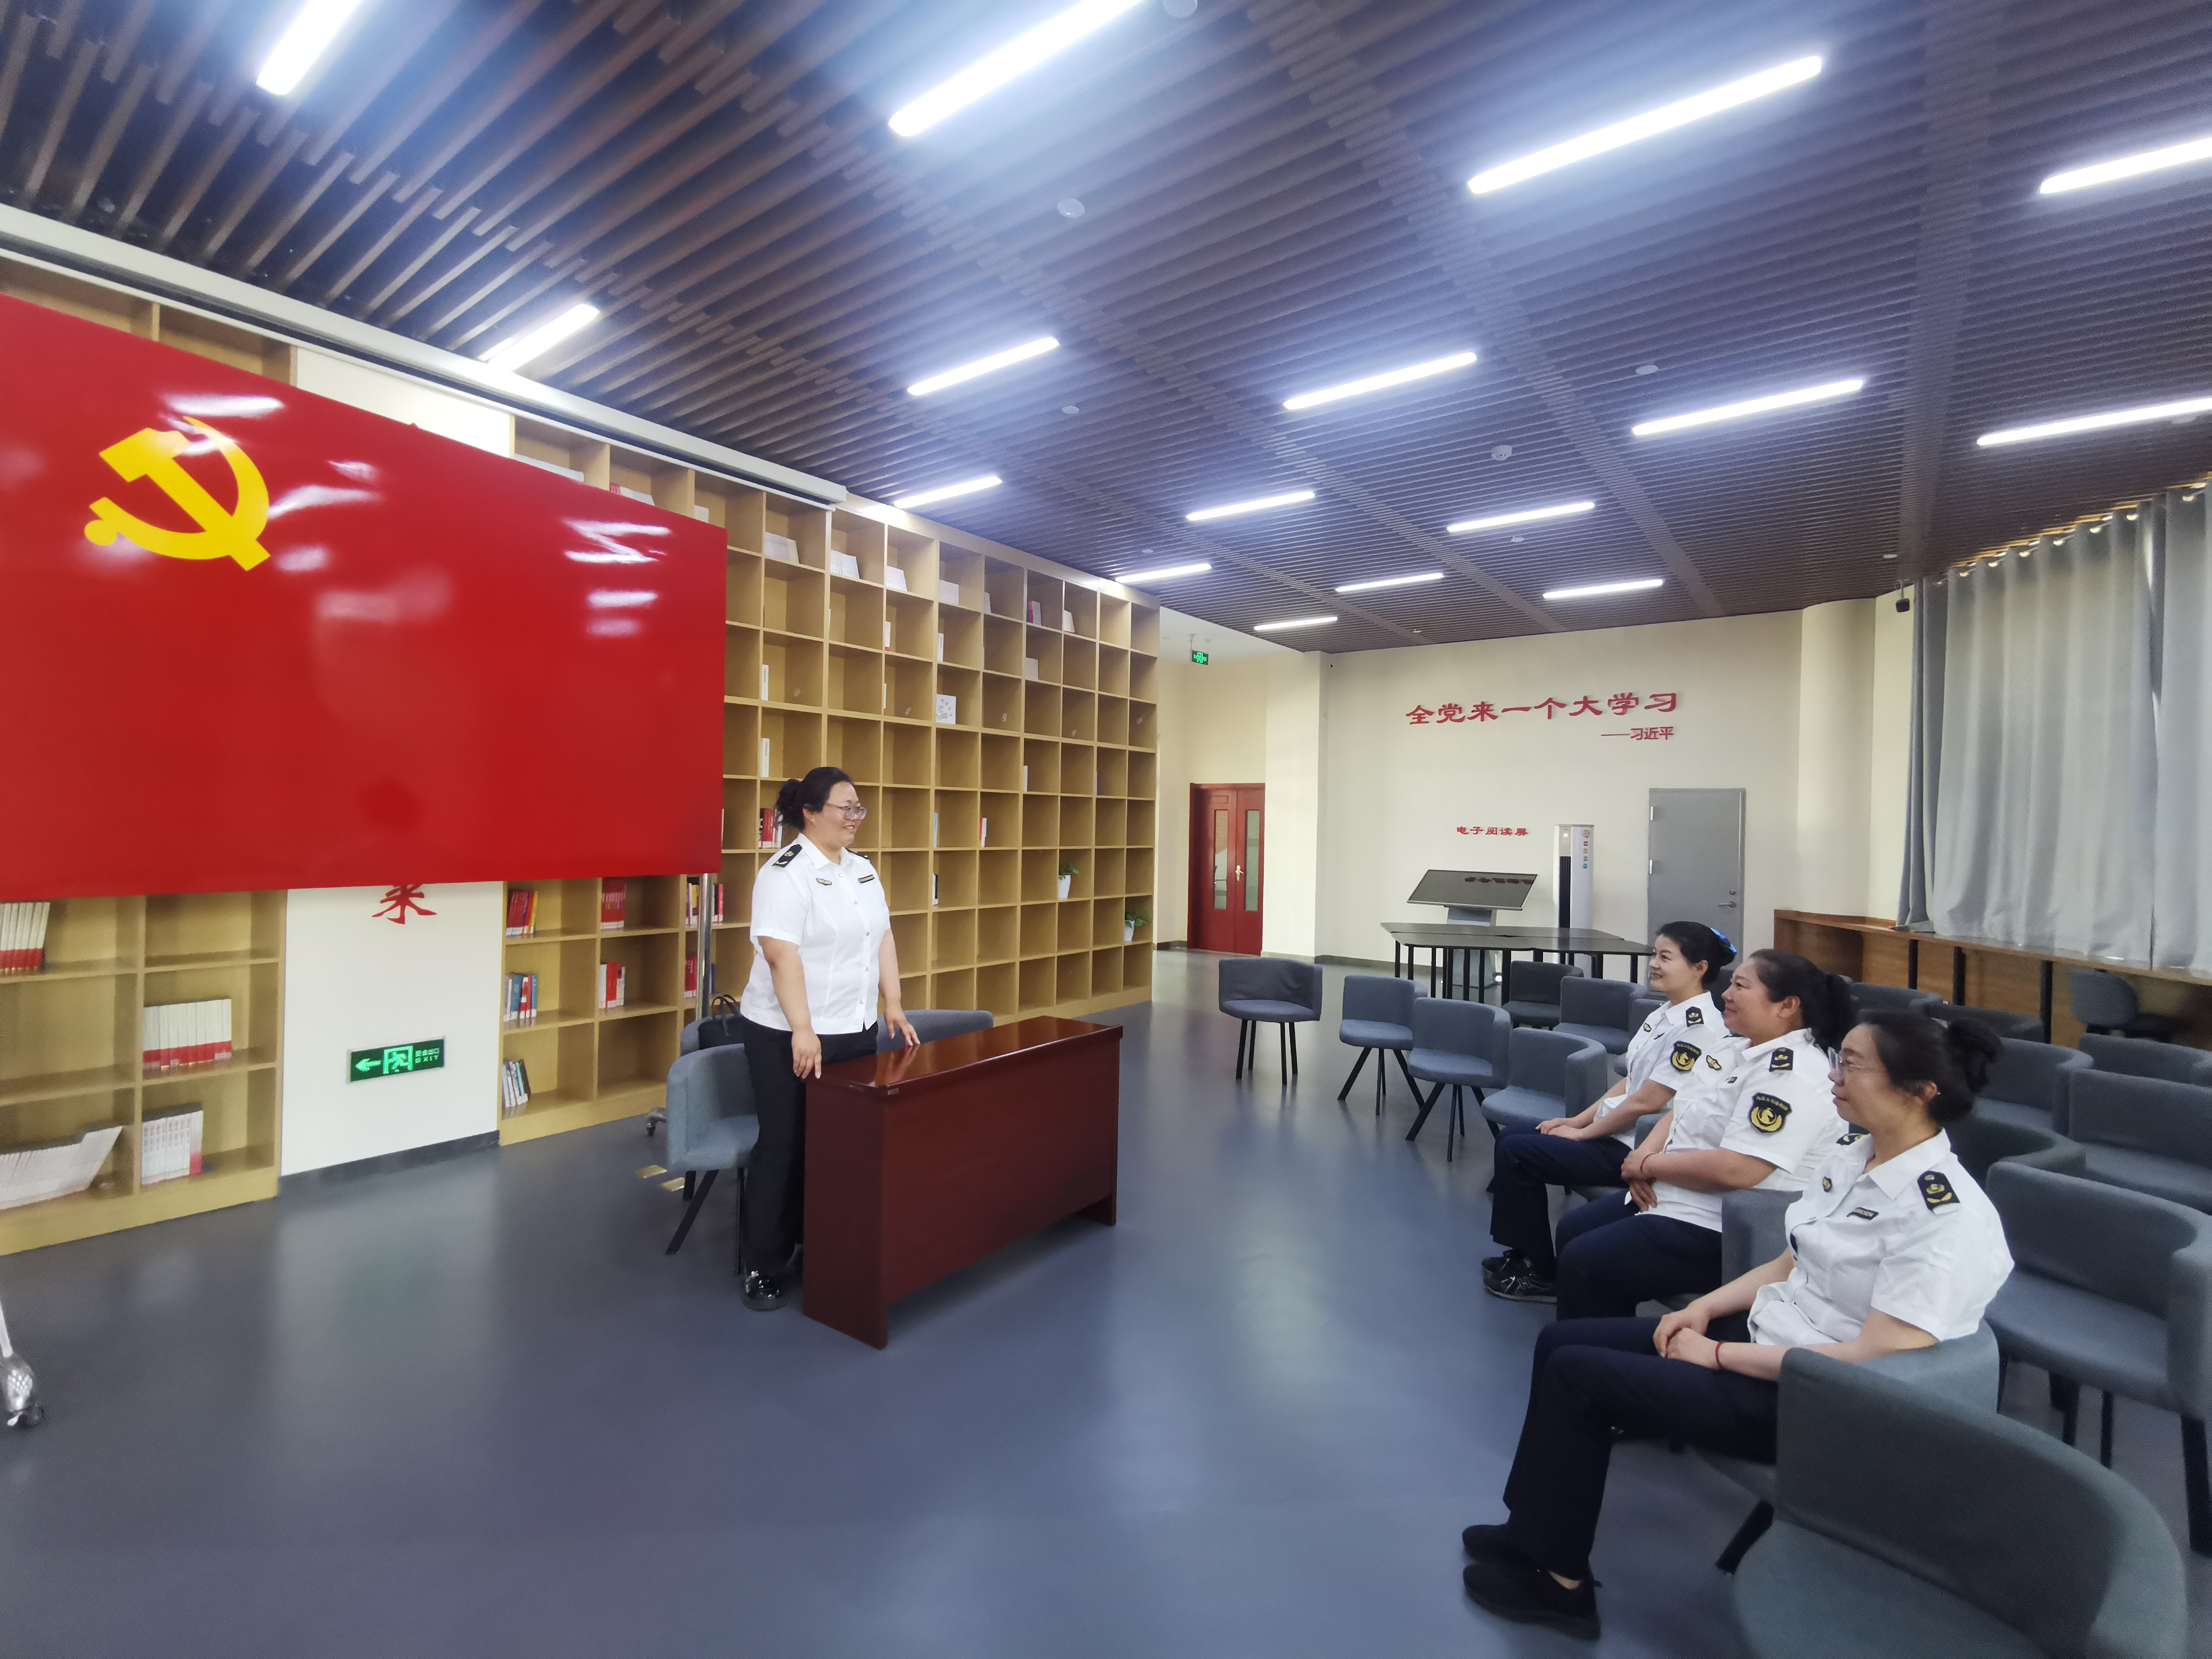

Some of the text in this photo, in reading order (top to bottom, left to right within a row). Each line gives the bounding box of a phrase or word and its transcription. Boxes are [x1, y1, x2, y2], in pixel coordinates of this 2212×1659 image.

[1405, 693, 1676, 725] 全党来一个大学习
[1456, 826, 1529, 836] 电子阅读屏
